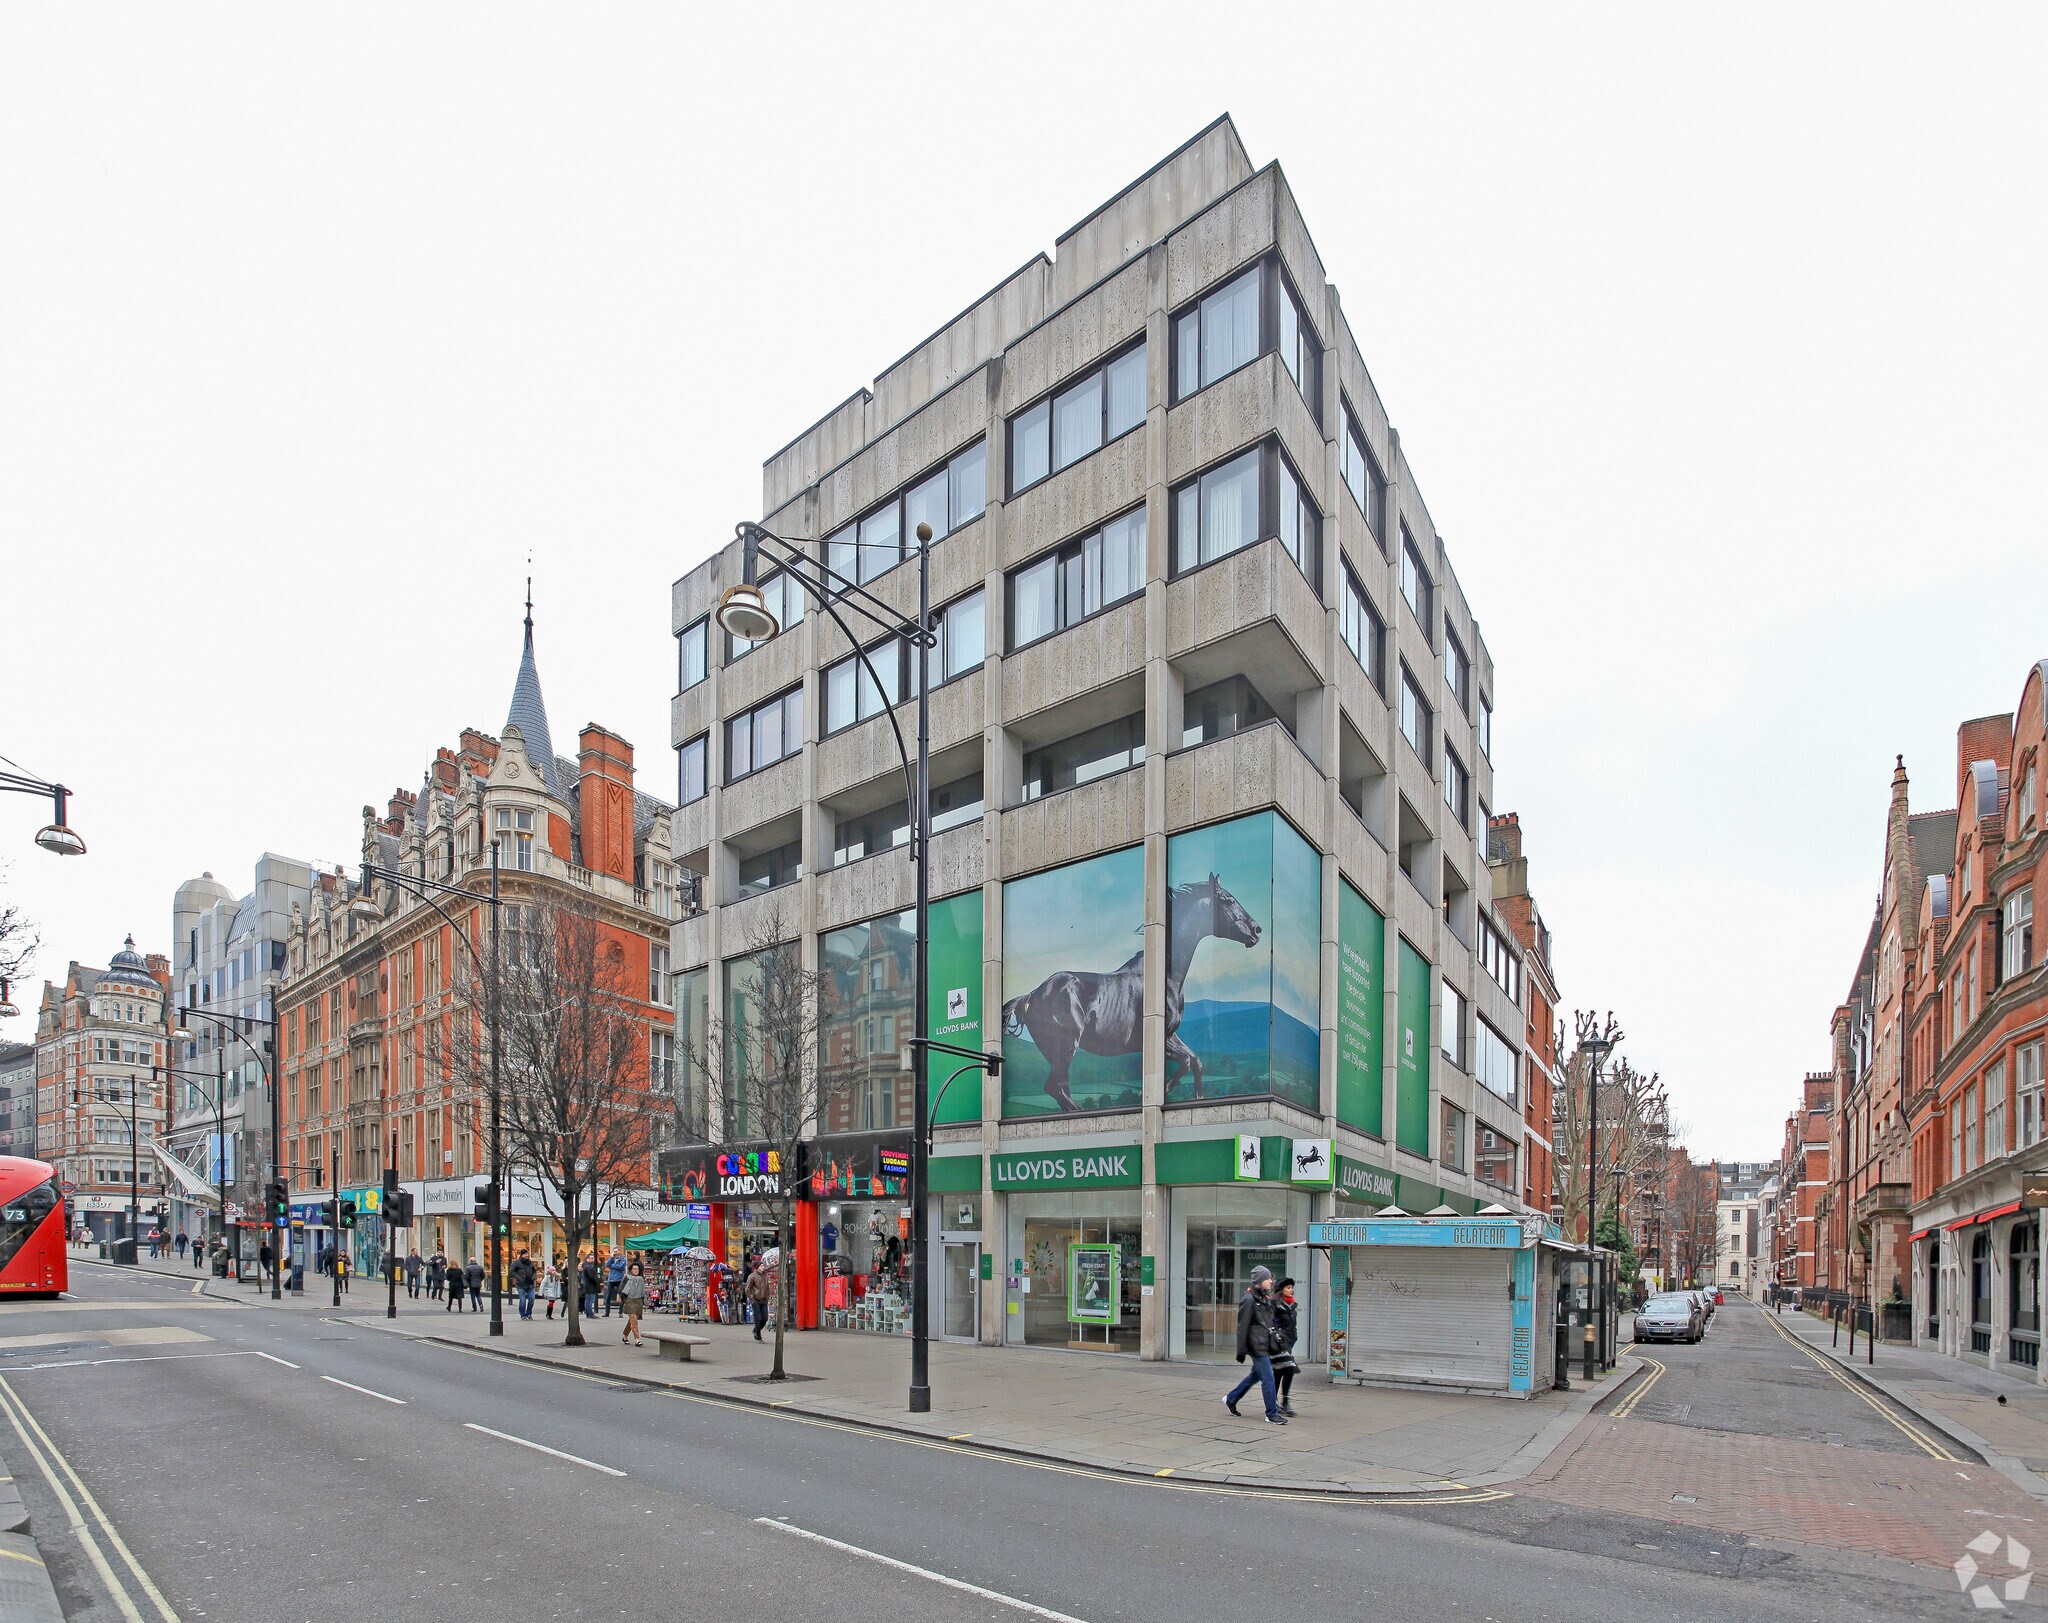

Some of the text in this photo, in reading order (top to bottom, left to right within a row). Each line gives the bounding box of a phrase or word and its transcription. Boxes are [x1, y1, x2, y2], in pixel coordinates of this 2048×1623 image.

[936, 1020, 979, 1035] LLOYDS BANK
[882, 1157, 908, 1166] LUGGAGE
[883, 1165, 907, 1173] FASHION
[997, 1155, 1129, 1181] LLOYDS BANK
[720, 1174, 779, 1196] LONDON
[1343, 1165, 1394, 1197] LLOYDS BANK
[6, 1210, 25, 1220] 73
[1322, 1226, 1506, 1244] GELATERIA GELATERIA
[1512, 1327, 1530, 1377] GELATERIA
